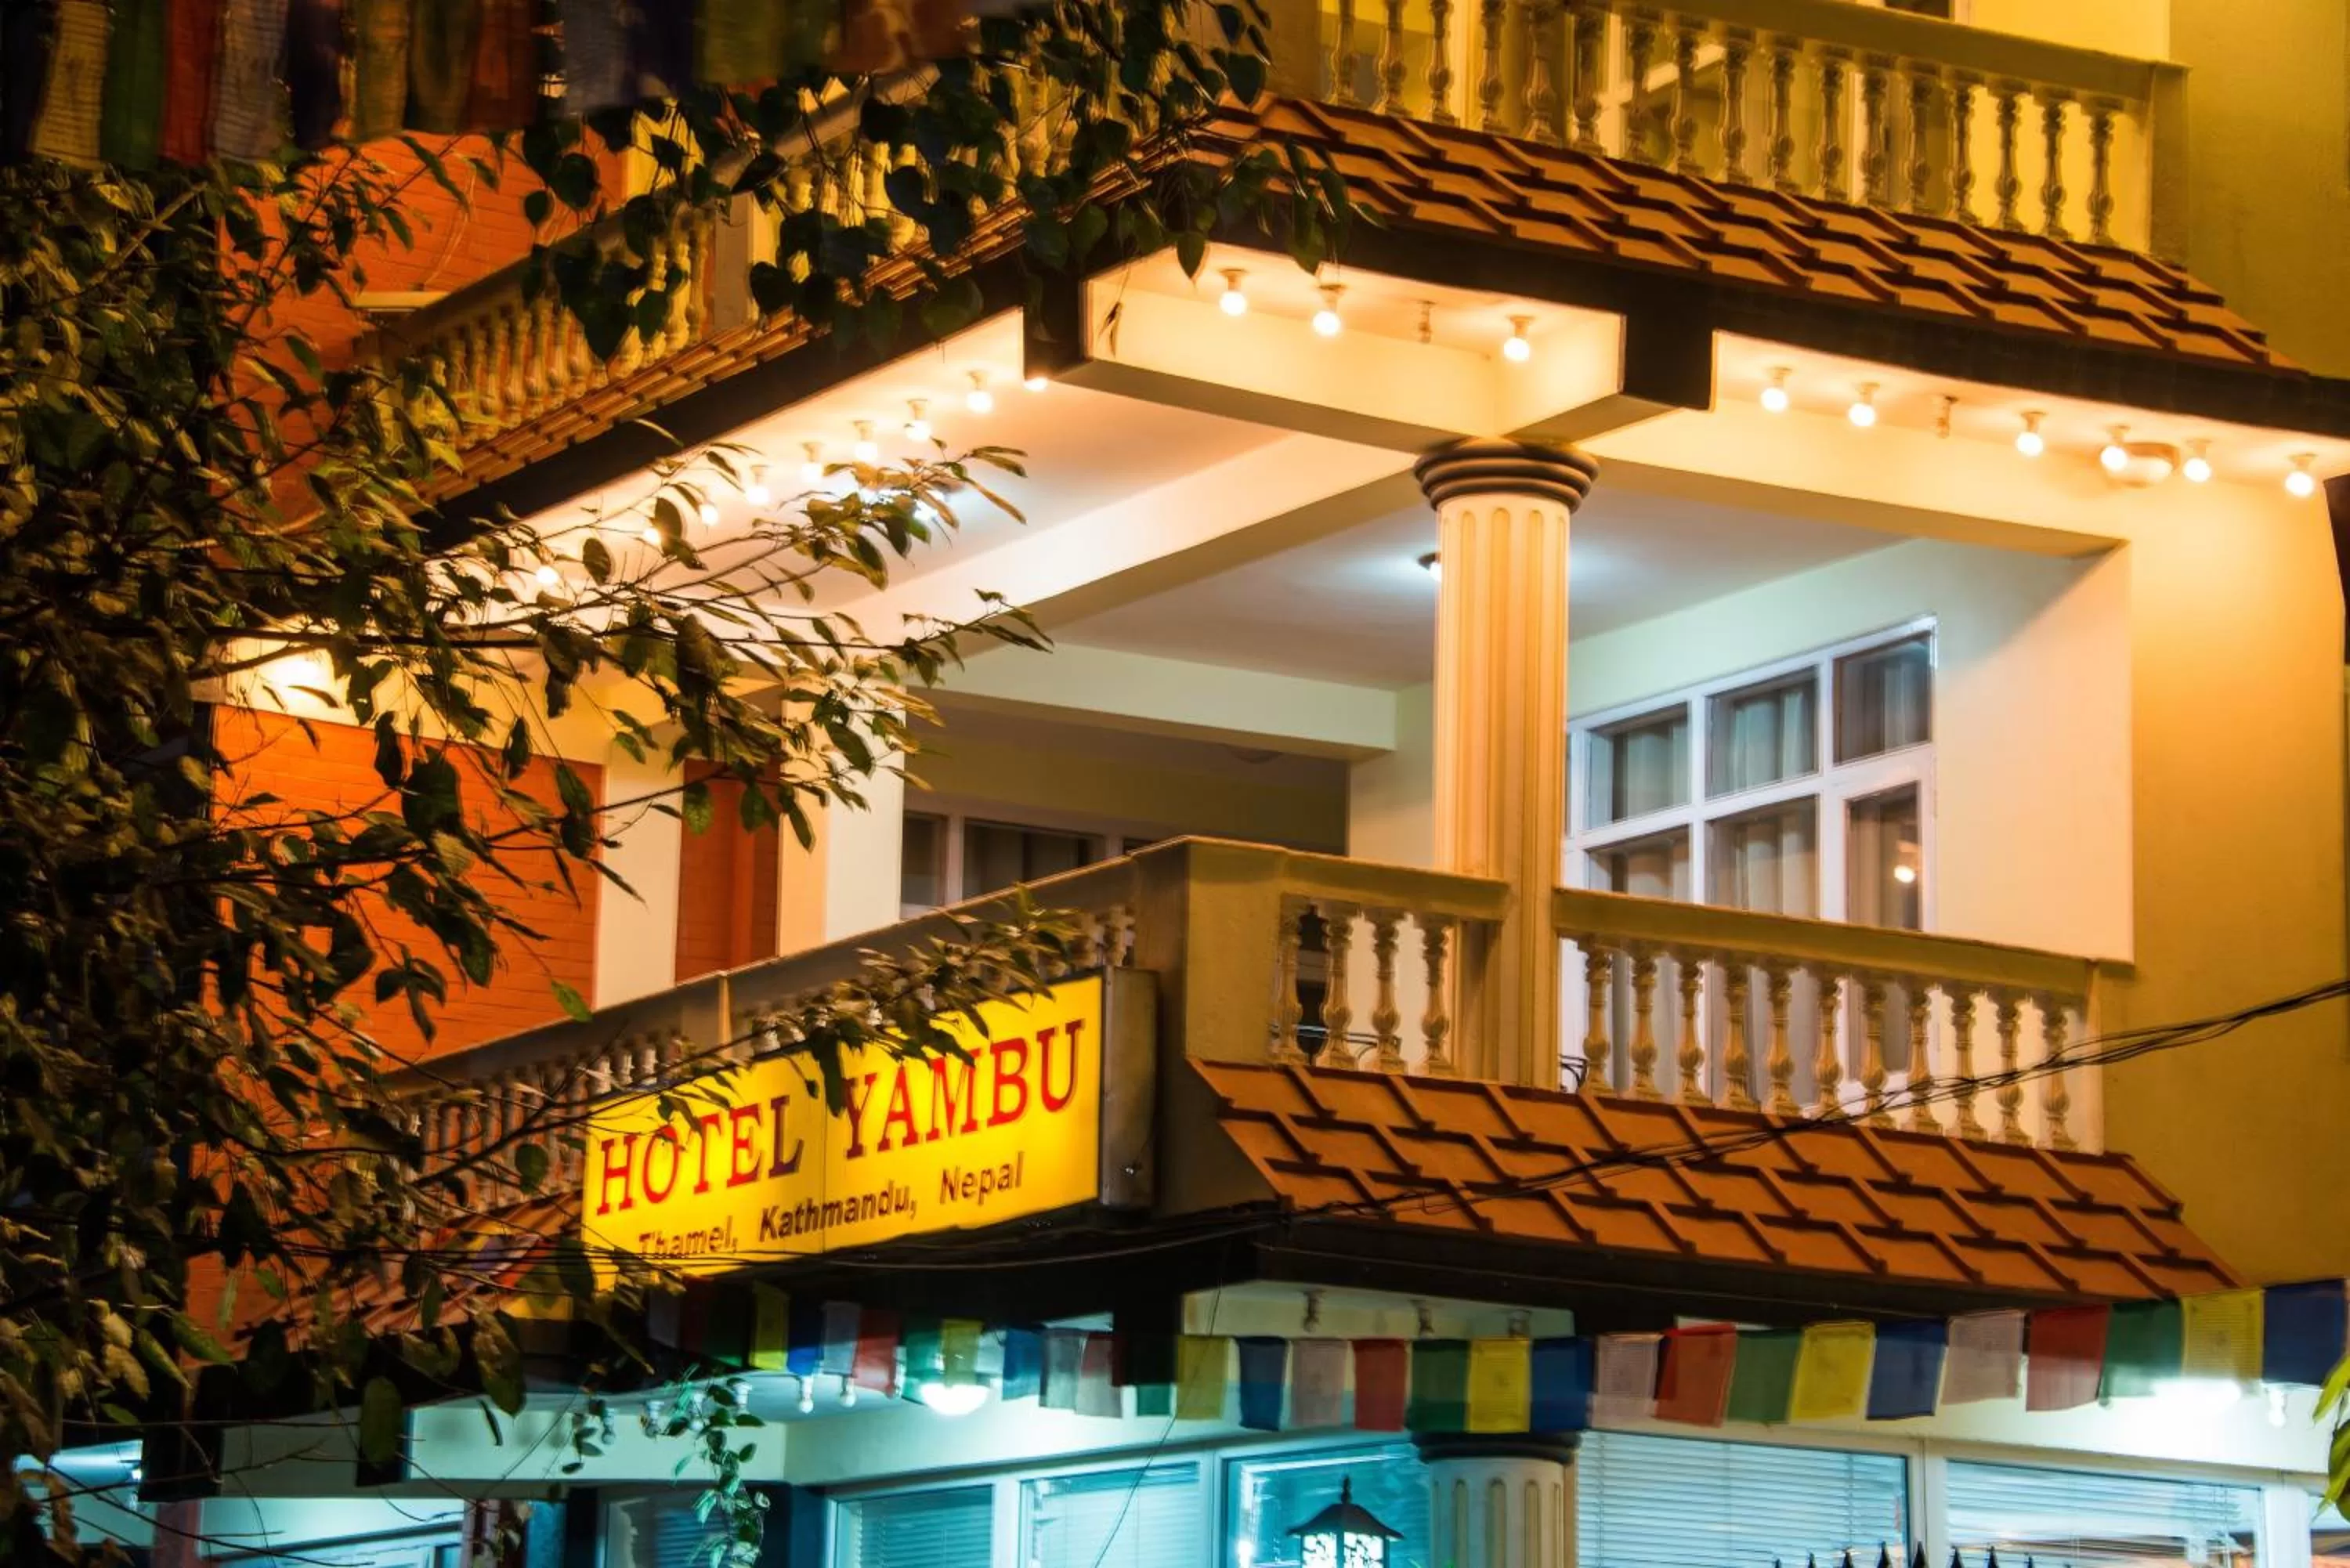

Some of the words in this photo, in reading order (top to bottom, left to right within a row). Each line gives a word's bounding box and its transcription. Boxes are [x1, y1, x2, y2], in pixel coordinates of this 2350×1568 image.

[596, 1094, 804, 1216] HOTEL
[841, 1018, 1085, 1160] YAMBU
[638, 1215, 738, 1258] Thamel,
[758, 1179, 917, 1243] Kathmandu,
[939, 1151, 1025, 1205] Nepal
